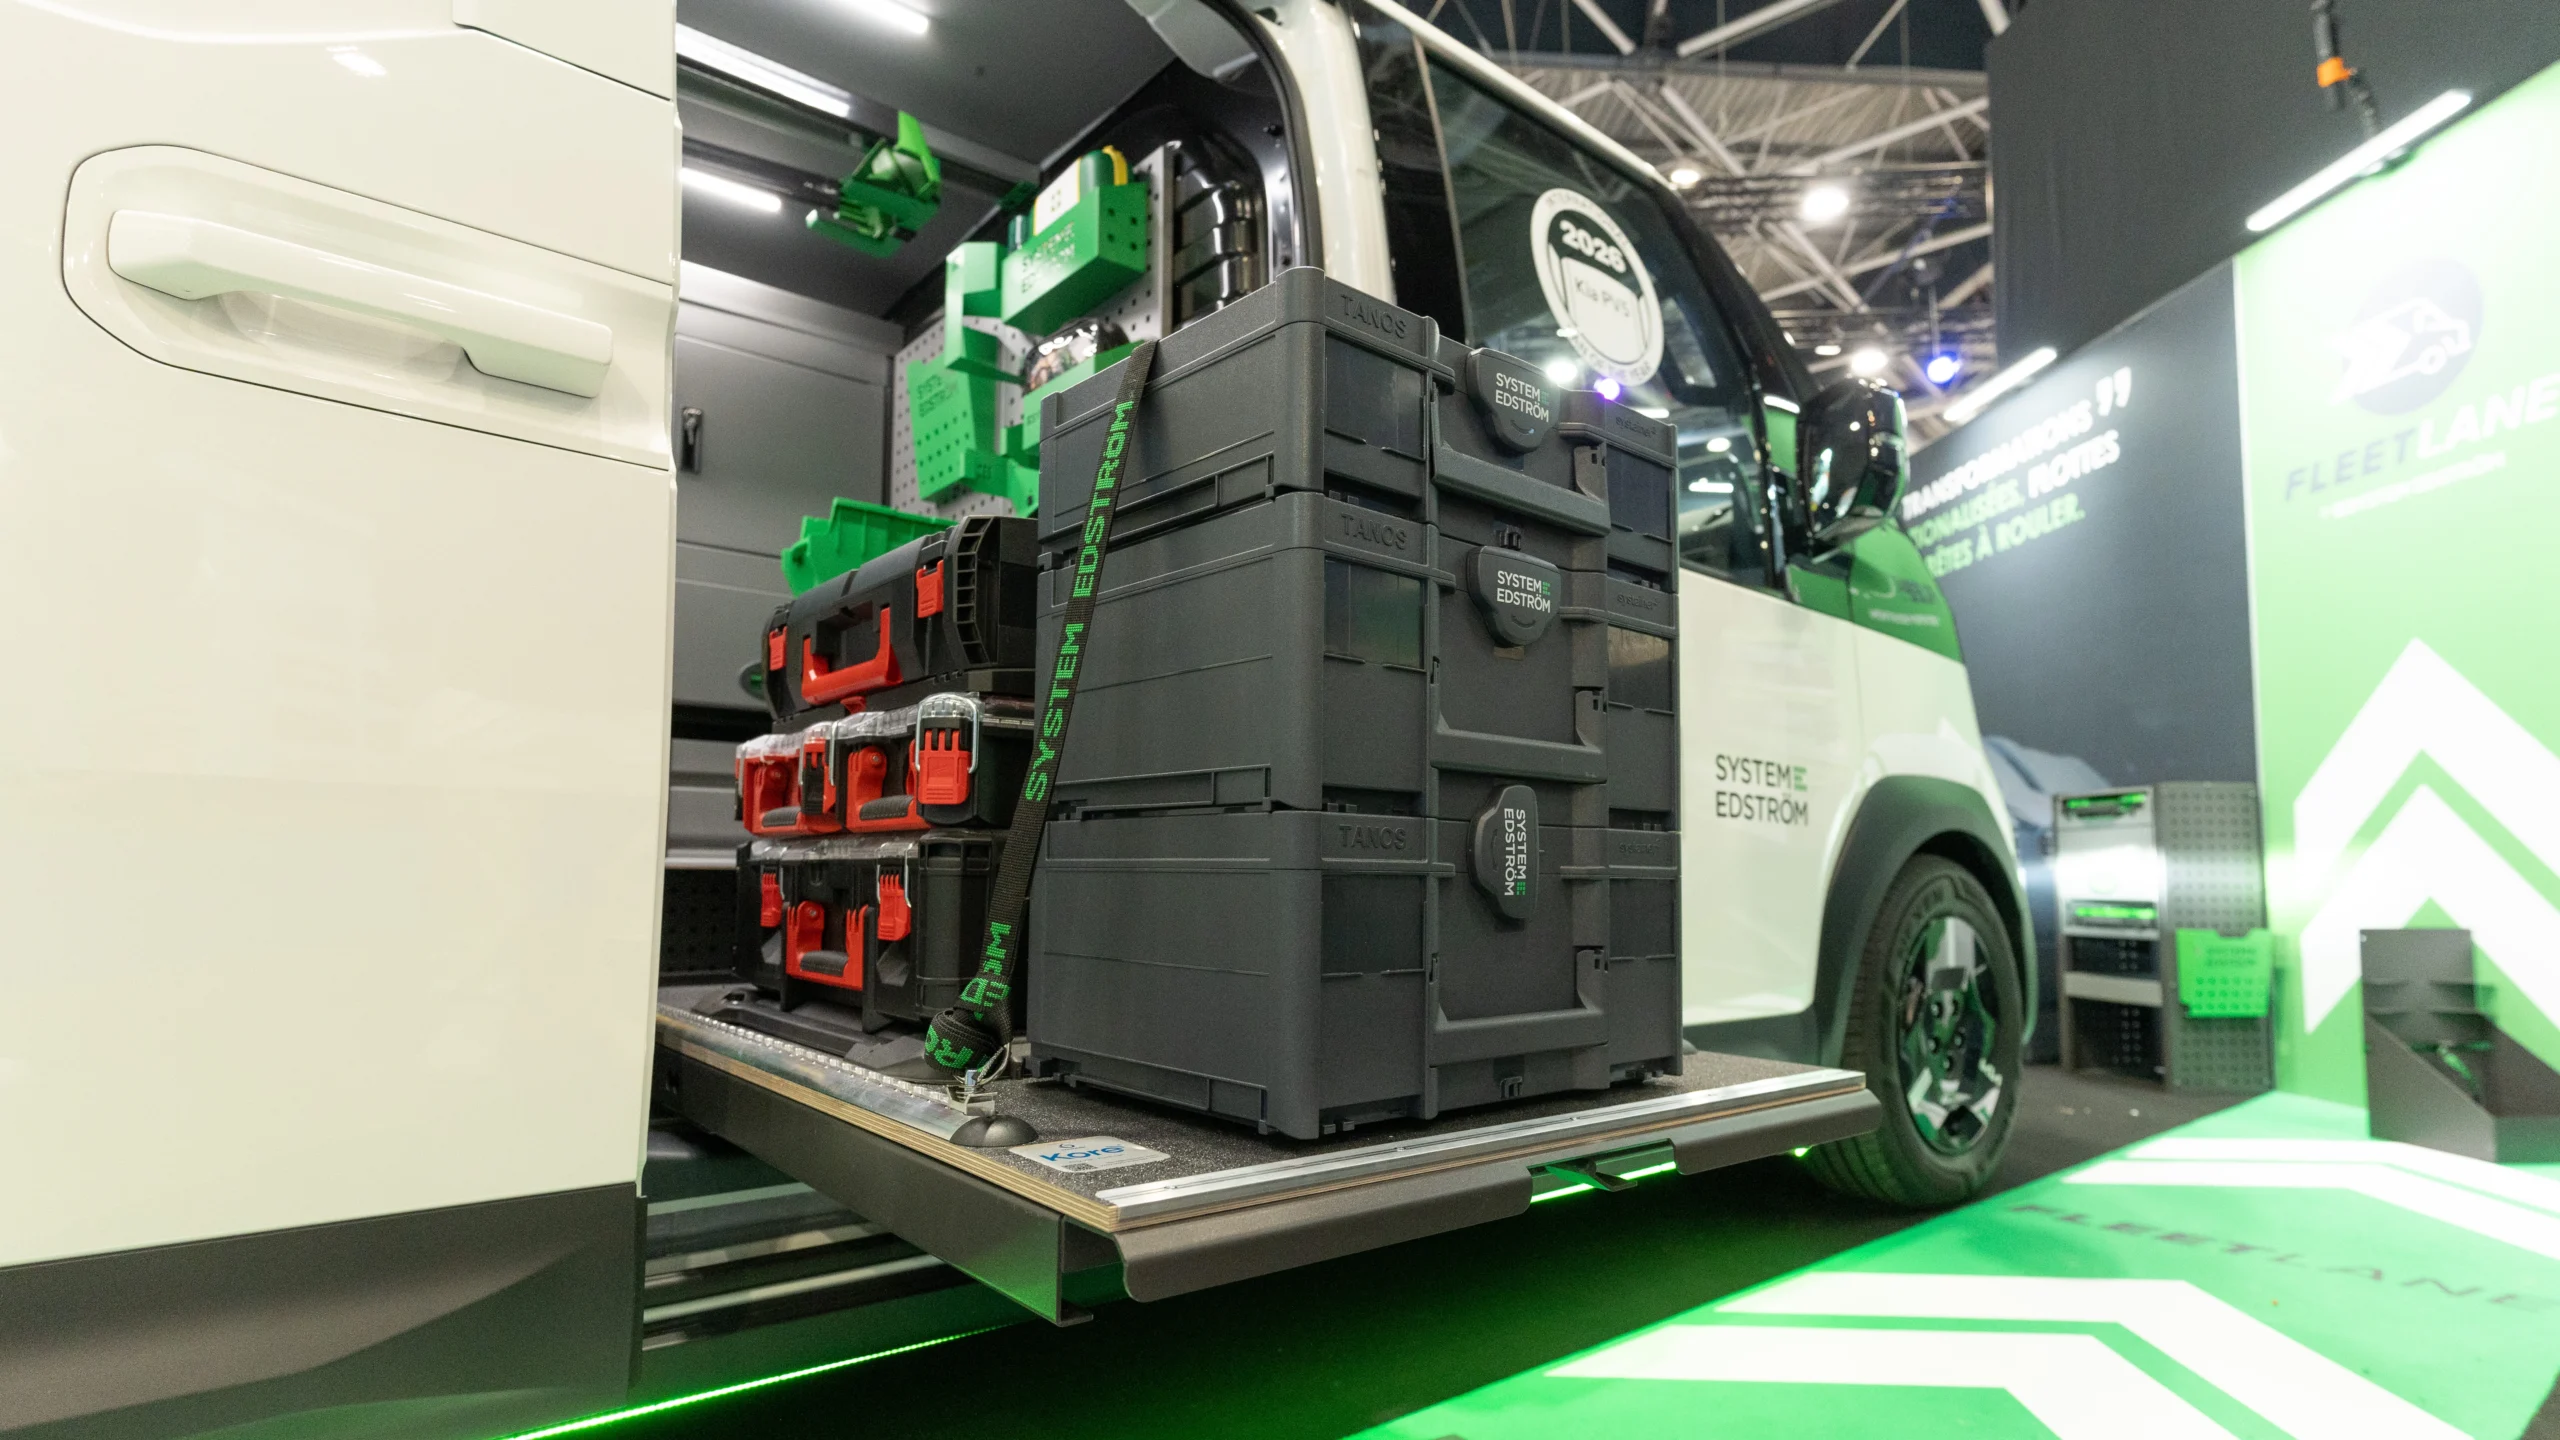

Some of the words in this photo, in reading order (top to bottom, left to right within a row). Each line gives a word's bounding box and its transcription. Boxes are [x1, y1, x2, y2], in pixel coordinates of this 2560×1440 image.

[1559, 220, 1626, 273] 2026
[1341, 294, 1406, 339] TANOS
[1495, 389, 1549, 422] EDSTRÖM
[1341, 513, 1407, 551] TANOS
[1496, 588, 1551, 614] EDSTRÖM
[1025, 623, 1084, 801] SYSTEM
[1716, 791, 1808, 826] EDSTRÖM
[1339, 824, 1407, 850] TANOS
[1504, 808, 1518, 896] EDSTRÖM
